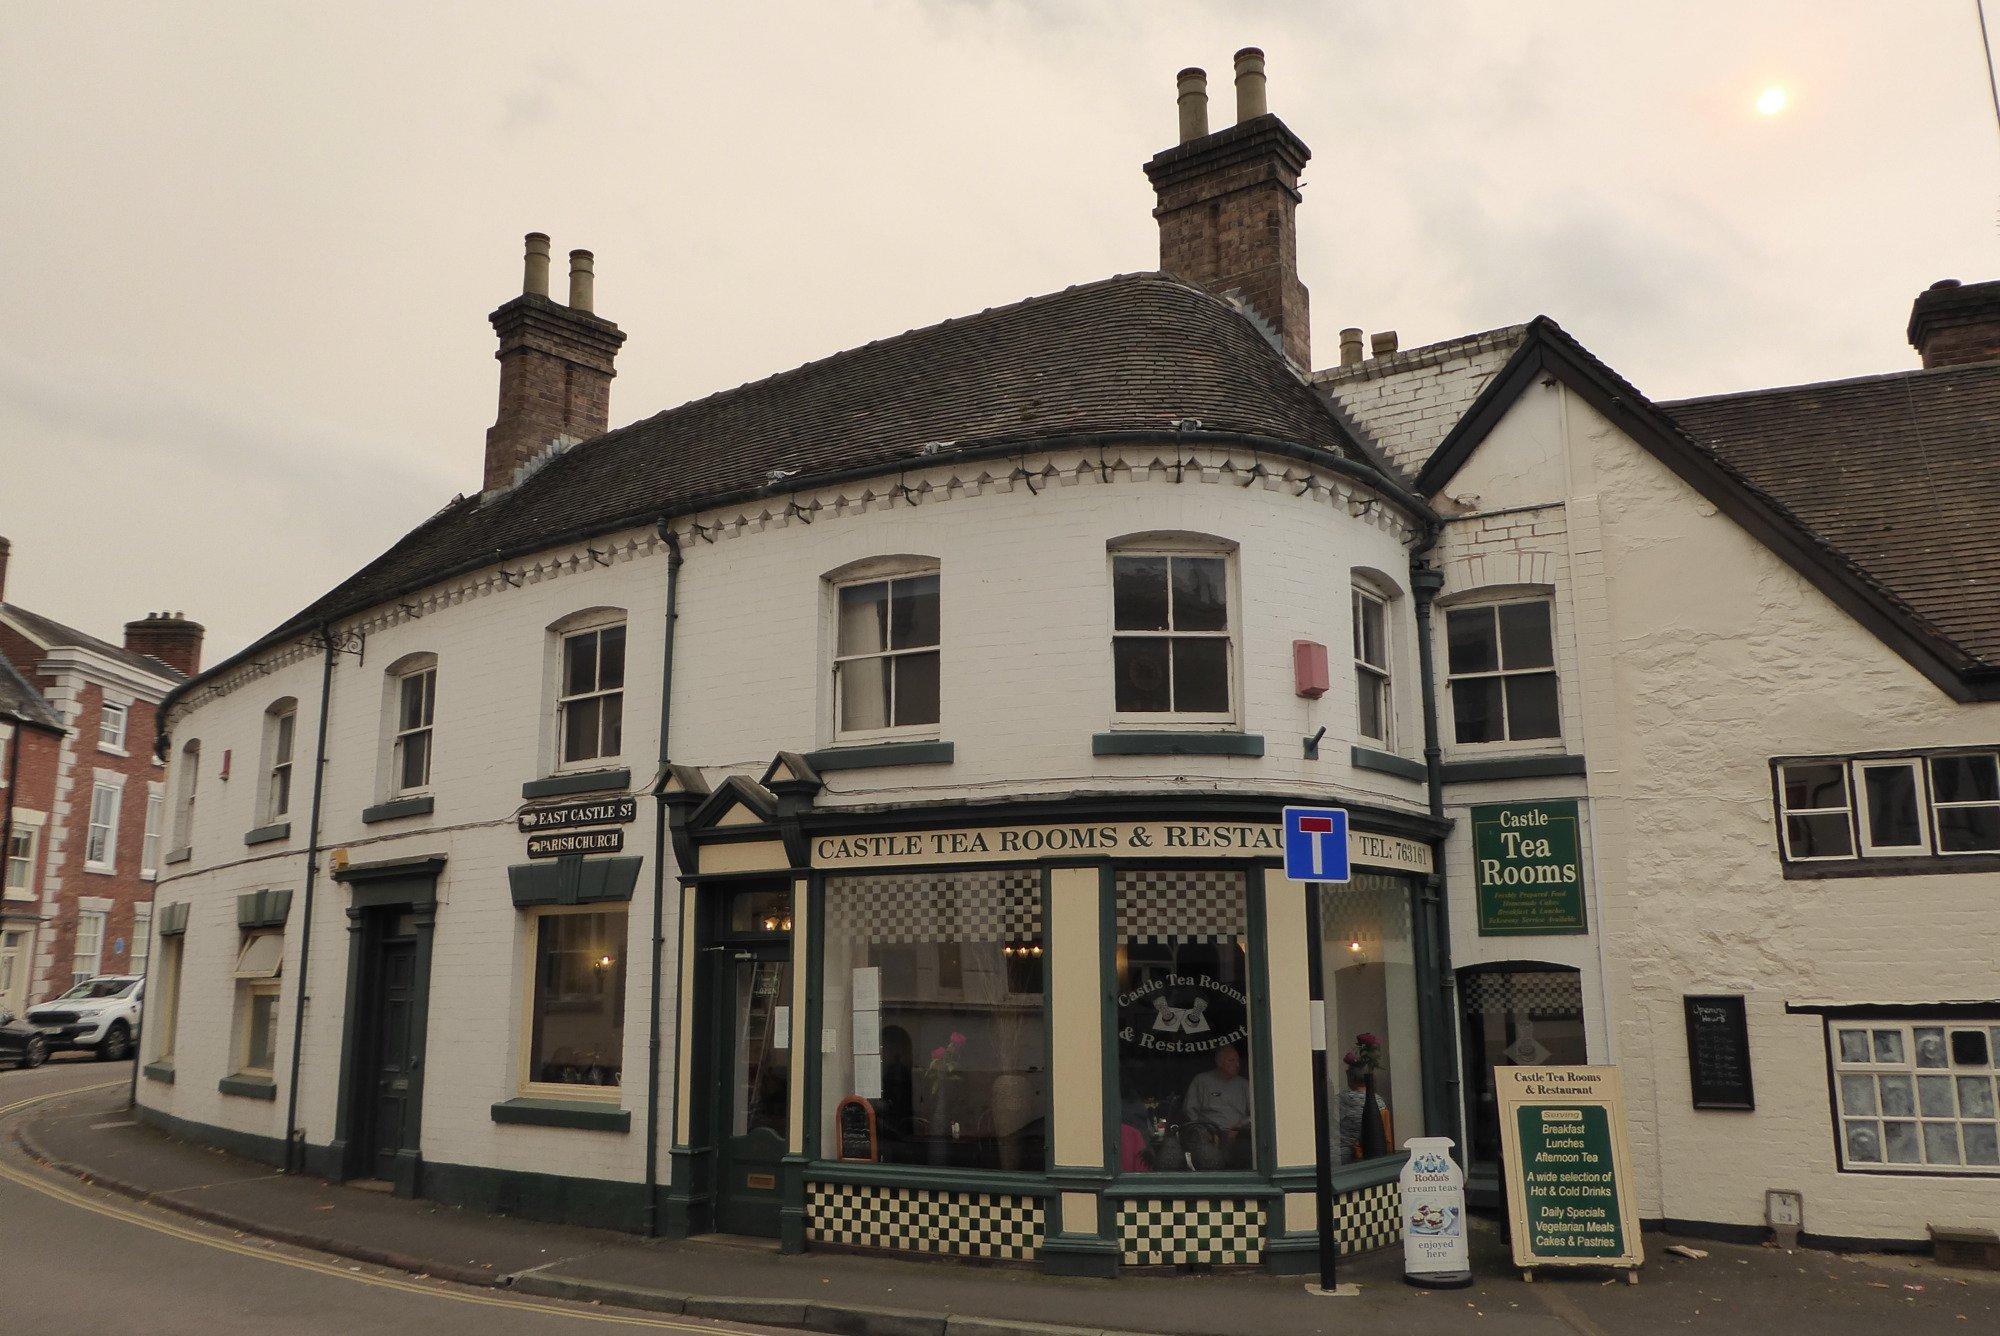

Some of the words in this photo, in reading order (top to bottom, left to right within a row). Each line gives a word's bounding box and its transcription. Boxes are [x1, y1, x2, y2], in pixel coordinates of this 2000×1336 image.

[539, 811, 568, 825] EAST
[570, 805, 615, 821] CASTLE
[1500, 809, 1549, 828] Castle
[540, 837, 574, 852] PARISH
[575, 834, 618, 849] CHURCH
[818, 835, 922, 859] CASTLE
[930, 832, 990, 853] TEA
[999, 826, 1118, 852] ROOMS
[1128, 826, 1153, 848] &
[1501, 832, 1551, 859] Tea
[1360, 836, 1393, 859] TEL:
[1396, 842, 1427, 865] 763161
[1480, 859, 1577, 886] Rooms
[1118, 978, 1163, 1007] Castle
[1166, 973, 1195, 986] Tea
[1199, 974, 1247, 1005] Rooms
[1118, 1026, 1135, 1042] &
[1140, 1024, 1249, 1052] Restaurant
[1514, 1072, 1544, 1082] Castle
[1546, 1072, 1565, 1082] Tea
[1567, 1072, 1602, 1082] Rooms
[1525, 1085, 1535, 1094] &
[1537, 1085, 1593, 1095] Restaurant
[1544, 1111, 1579, 1119] Serving
[1542, 1124, 1585, 1134] Breakfast
[1546, 1138, 1584, 1148] Lunches
[1535, 1152, 1579, 1163] Afternoon
[1582, 1152, 1598, 1163] Tea
[1527, 1172, 1535, 1181] A
[1536, 1172, 1557, 1182] wide
[1560, 1172, 1600, 1182] selection
[1602, 1171, 1612, 1182] of
[1531, 1186, 1547, 1196] Hot
[1549, 1187, 1557, 1196] &
[1558, 1186, 1580, 1196] Cold
[1582, 1186, 1611, 1196] Drinks
[1541, 1207, 1564, 1219] Daily
[1566, 1207, 1605, 1219] Specials
[1535, 1221, 1584, 1234] Vegetarian
[1586, 1221, 1615, 1232] Meals
[1418, 1240, 1454, 1250] enjoyed
[1536, 1236, 1565, 1246] Cakes
[1567, 1236, 1575, 1246] &
[1577, 1236, 1615, 1247] Pastries
[1426, 1249, 1447, 1258] here
